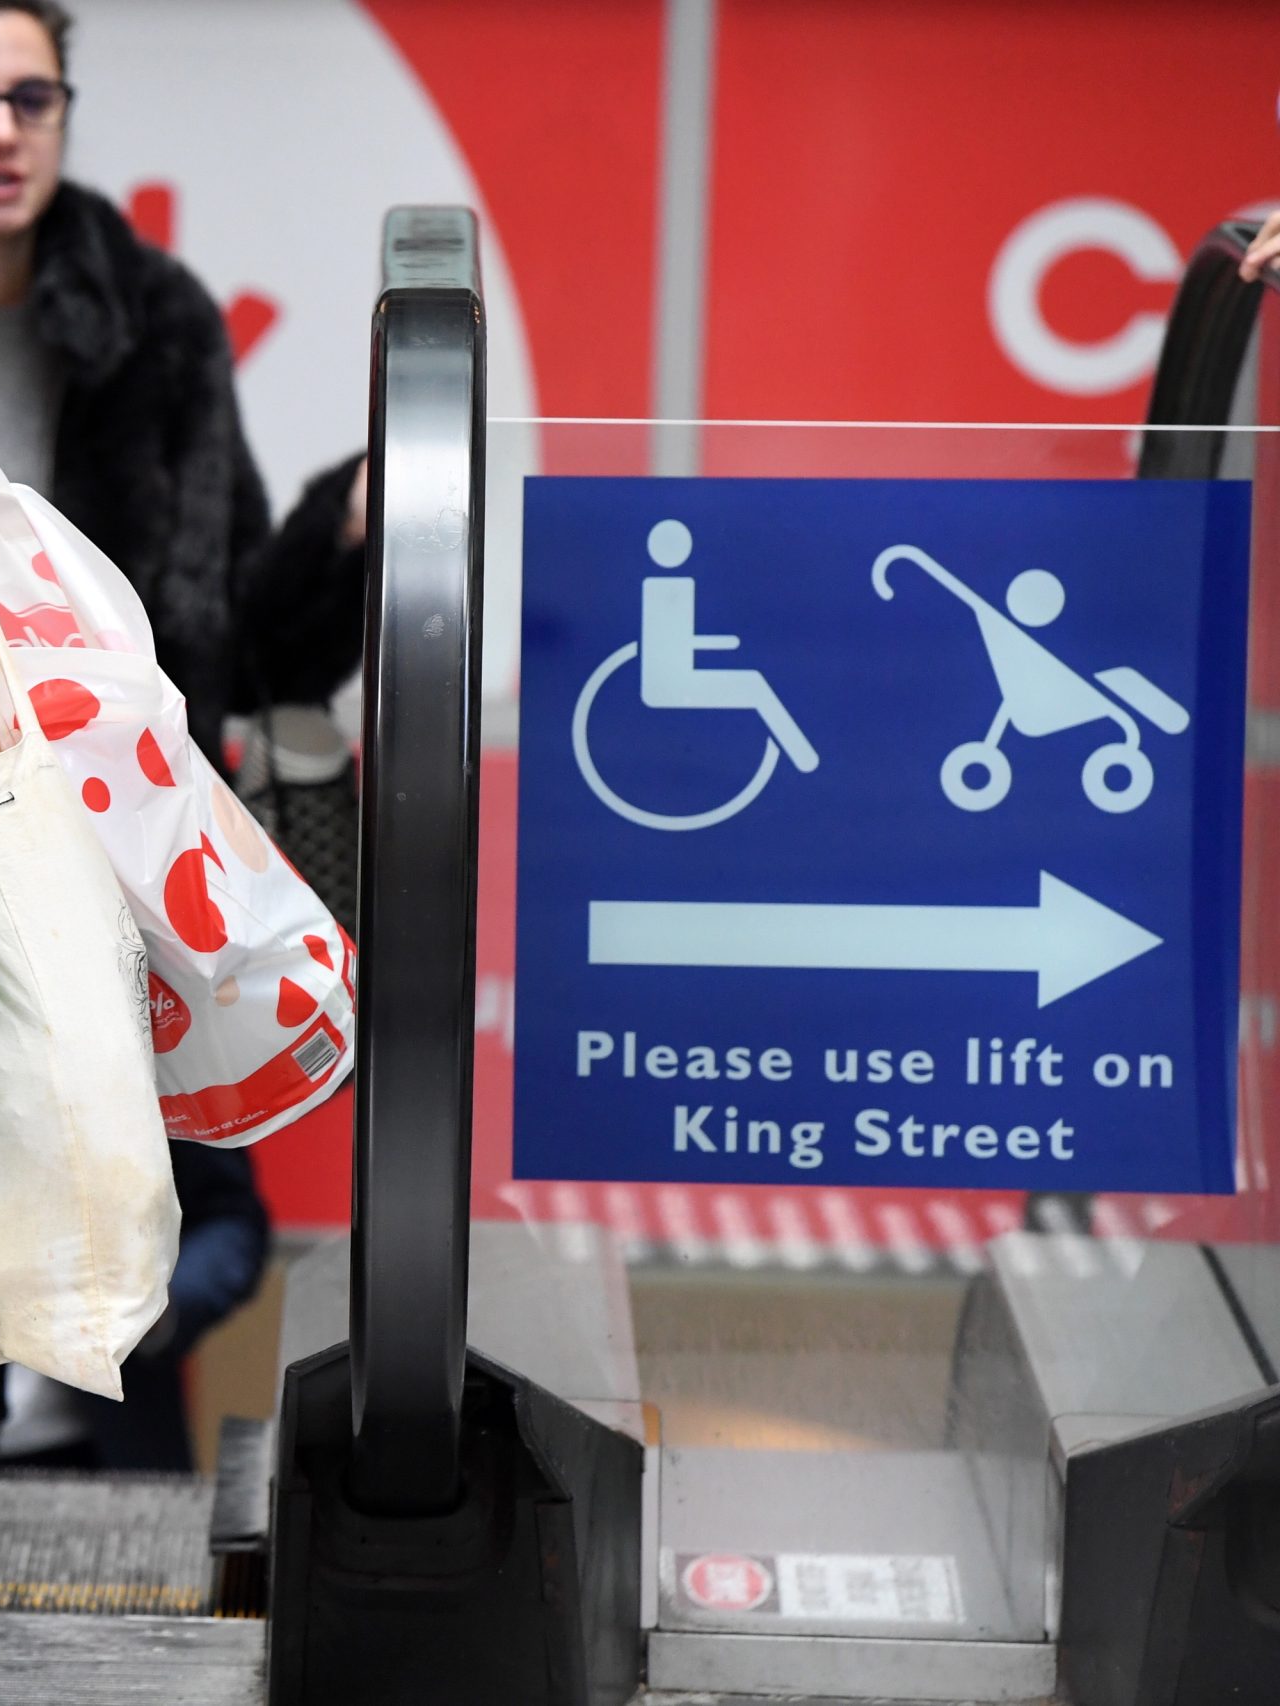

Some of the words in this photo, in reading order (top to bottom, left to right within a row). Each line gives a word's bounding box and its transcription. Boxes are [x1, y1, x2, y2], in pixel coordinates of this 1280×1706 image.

[577, 1031, 793, 1081] Please
[824, 1048, 935, 1084] use
[966, 1037, 1064, 1087] lift
[1092, 1053, 1173, 1088] on
[673, 1105, 825, 1169] King
[854, 1108, 1075, 1161] Street
